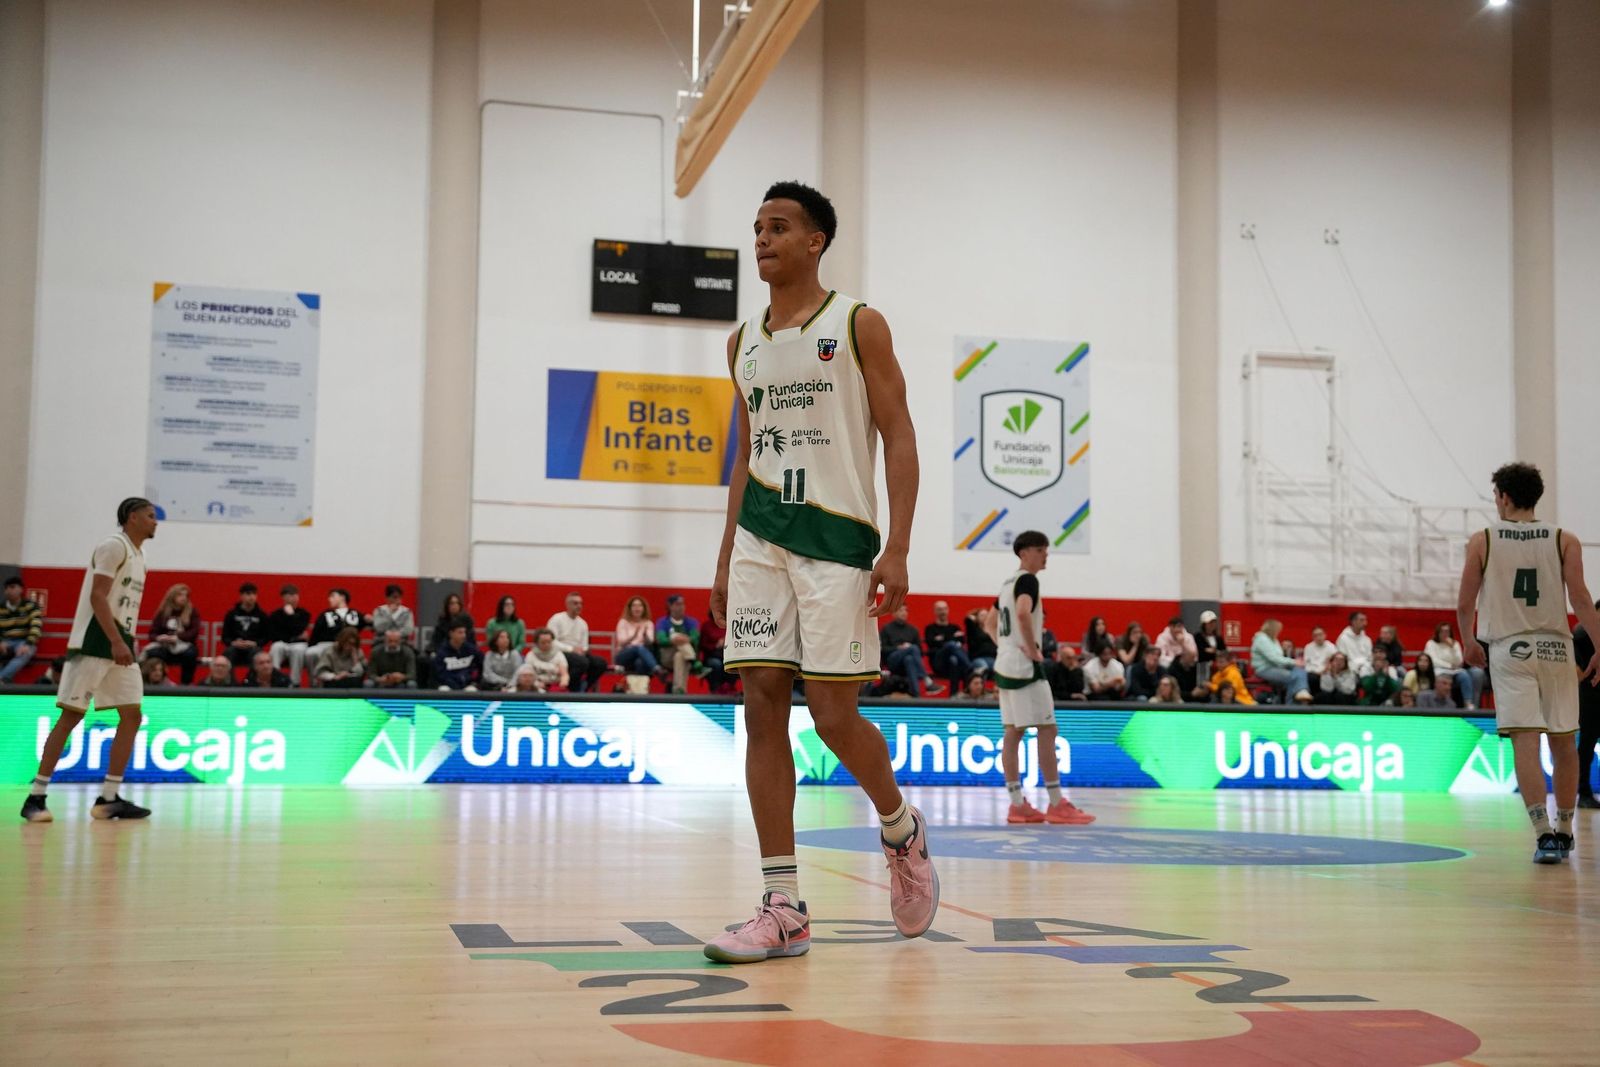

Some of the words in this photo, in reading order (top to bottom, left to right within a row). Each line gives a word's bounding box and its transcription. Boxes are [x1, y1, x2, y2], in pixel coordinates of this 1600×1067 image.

[600, 270, 639, 285] LOCAL
[175, 301, 199, 311] LOS
[201, 303, 274, 316] PRINCIPIOS
[277, 307, 299, 318] DEL
[183, 312, 216, 323] BUEN
[218, 315, 291, 328] AFICIONADO
[616, 380, 704, 394] POLIDEPORTIVO
[768, 379, 833, 397] Fundación
[770, 393, 814, 411] Unicaja
[629, 400, 691, 426] Blas
[604, 426, 713, 452] Infante
[806, 437, 830, 445] Torre
[993, 440, 1050, 453] Fundación
[1002, 454, 1043, 466] Unicaja
[994, 466, 1051, 477] Baloncesto
[781, 467, 806, 504] 11
[1498, 529, 1549, 541] TRUJILLO
[1513, 568, 1540, 607] 4
[735, 607, 771, 616] CLINICAS
[124, 617, 133, 632] 5
[734, 640, 768, 649] DENTAL
[1536, 640, 1567, 650] COSTA
[1537, 648, 1552, 656] DEL
[1553, 649, 1568, 657] SOL
[1537, 654, 1568, 664] MÁLAGA
[1214, 730, 1405, 792] Unicaja
